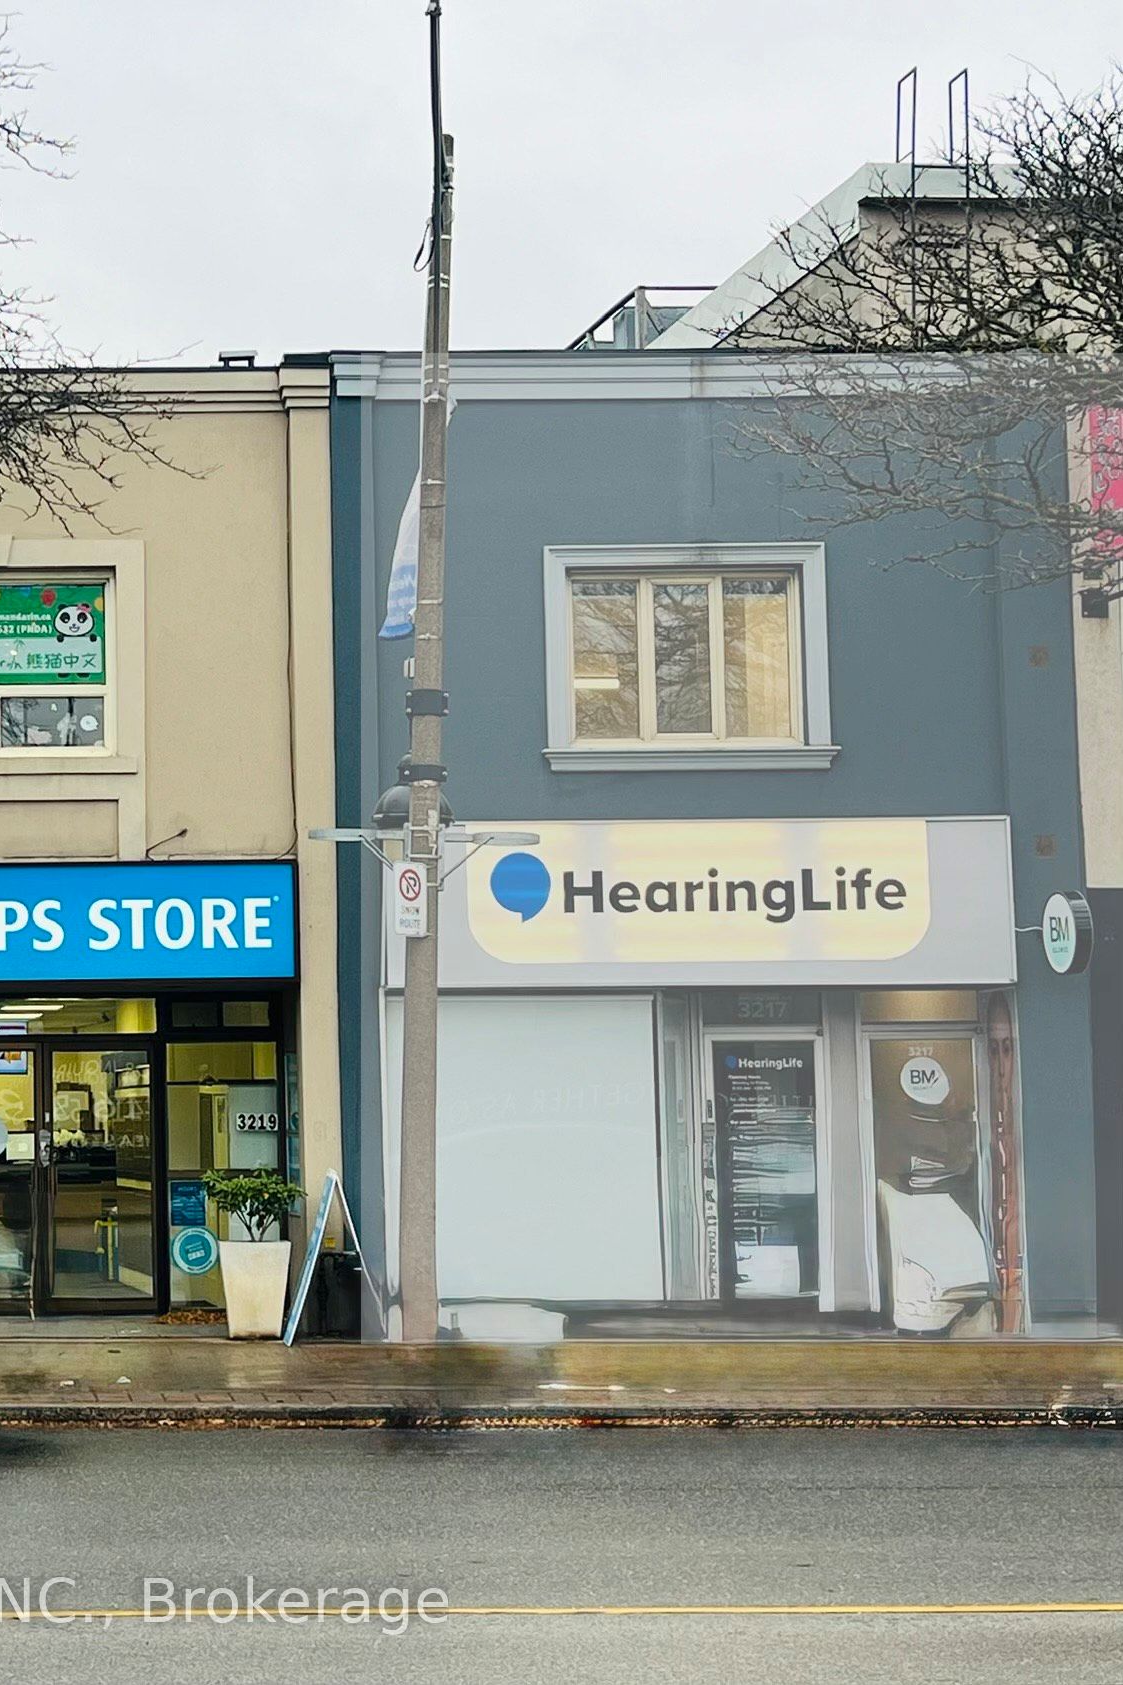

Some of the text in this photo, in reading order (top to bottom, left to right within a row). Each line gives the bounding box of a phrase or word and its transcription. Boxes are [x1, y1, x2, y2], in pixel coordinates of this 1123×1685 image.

[27, 652, 97, 670] 熊猫中文
[562, 867, 908, 924] HearingLife
[87, 897, 274, 951] STORE
[1049, 916, 1070, 943] BM
[737, 1001, 788, 1018] 3217
[907, 1046, 934, 1057] 3217
[738, 1057, 804, 1071] HearingLife
[909, 1069, 938, 1085] BM
[237, 1113, 278, 1131] 3219
